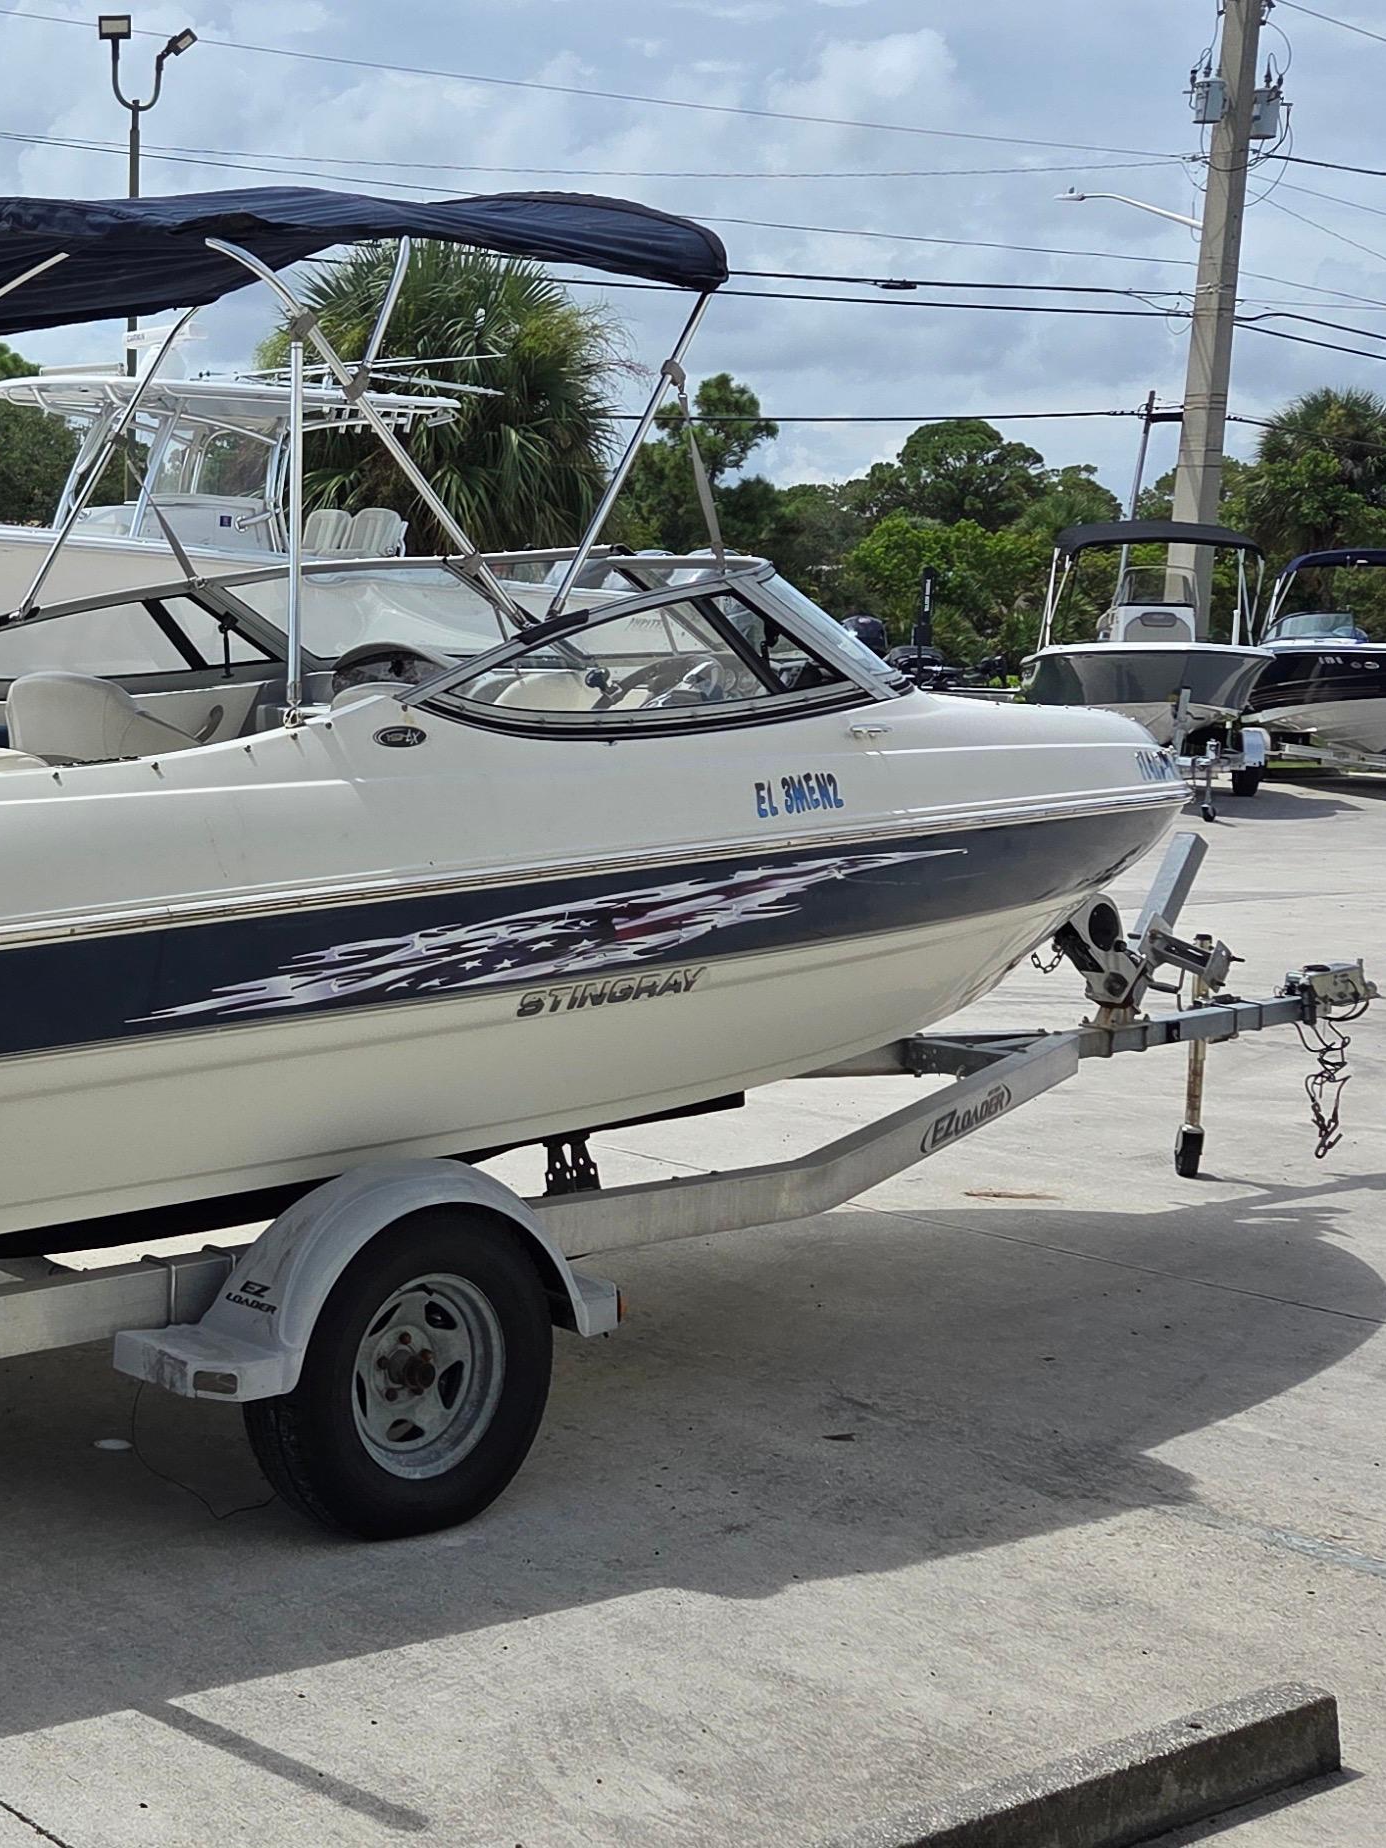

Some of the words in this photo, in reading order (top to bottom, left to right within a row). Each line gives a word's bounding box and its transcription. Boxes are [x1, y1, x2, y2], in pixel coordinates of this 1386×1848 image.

[754, 781, 778, 818] EL
[516, 966, 708, 1018] STINGRAY
[225, 1292, 278, 1315] LOADER
[240, 1280, 272, 1298] EZ
